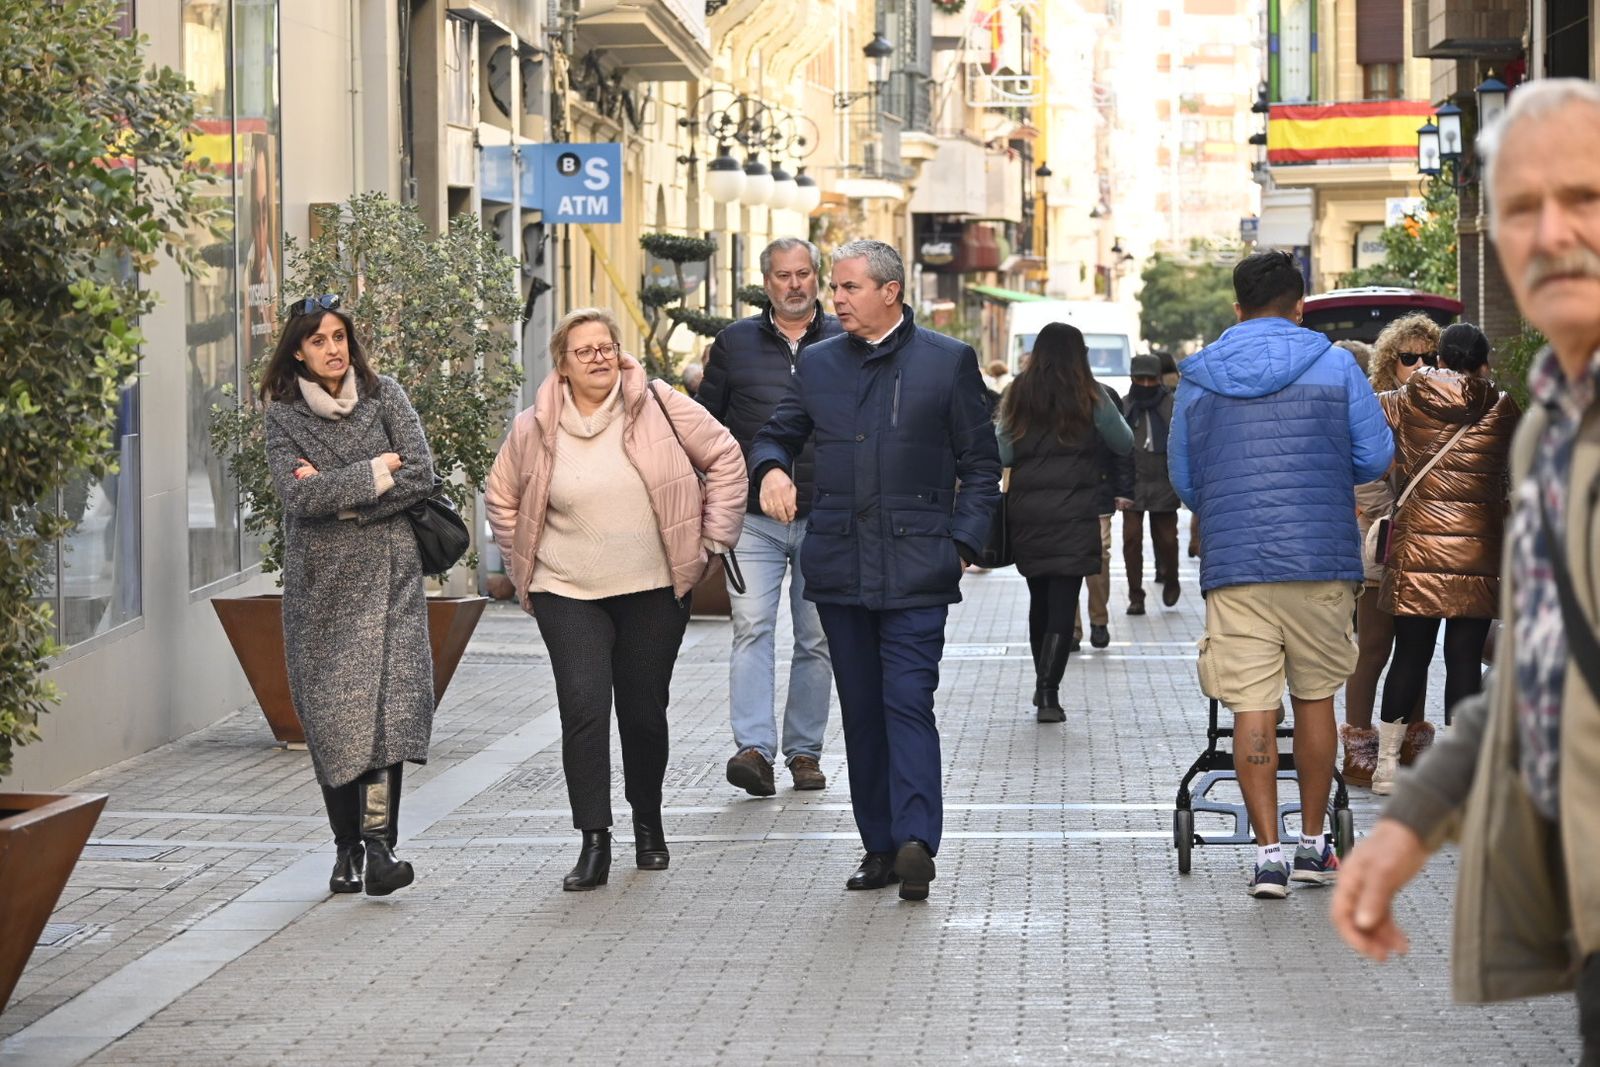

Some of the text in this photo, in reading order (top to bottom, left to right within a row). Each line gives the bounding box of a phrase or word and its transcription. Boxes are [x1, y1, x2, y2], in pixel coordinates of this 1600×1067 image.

[563, 157, 610, 191] B S
[558, 196, 608, 215] ATM
